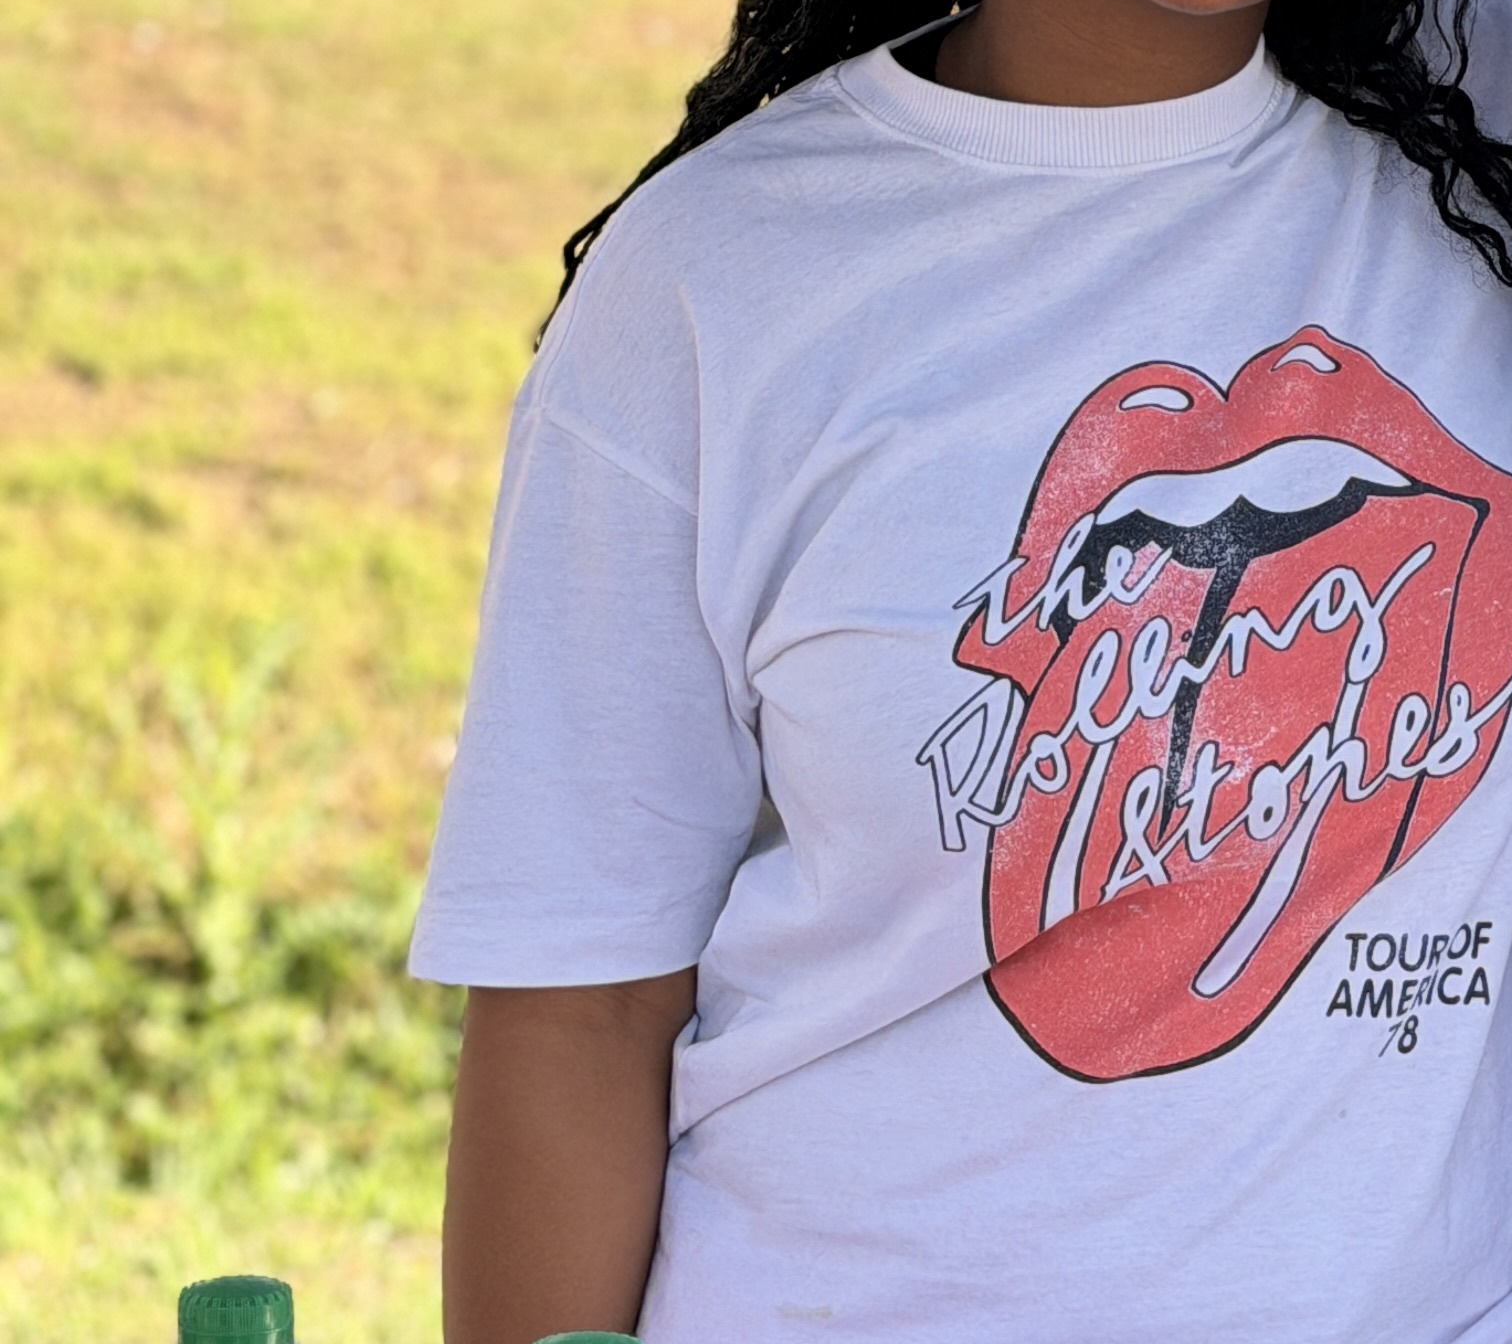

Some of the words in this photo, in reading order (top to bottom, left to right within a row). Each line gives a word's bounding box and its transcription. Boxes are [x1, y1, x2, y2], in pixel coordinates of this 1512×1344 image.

[917, 544, 1434, 852] Rolling
[1345, 932, 1449, 973] TOUR
[1447, 921, 1493, 960] OF
[1326, 966, 1491, 1018] AMERICA
